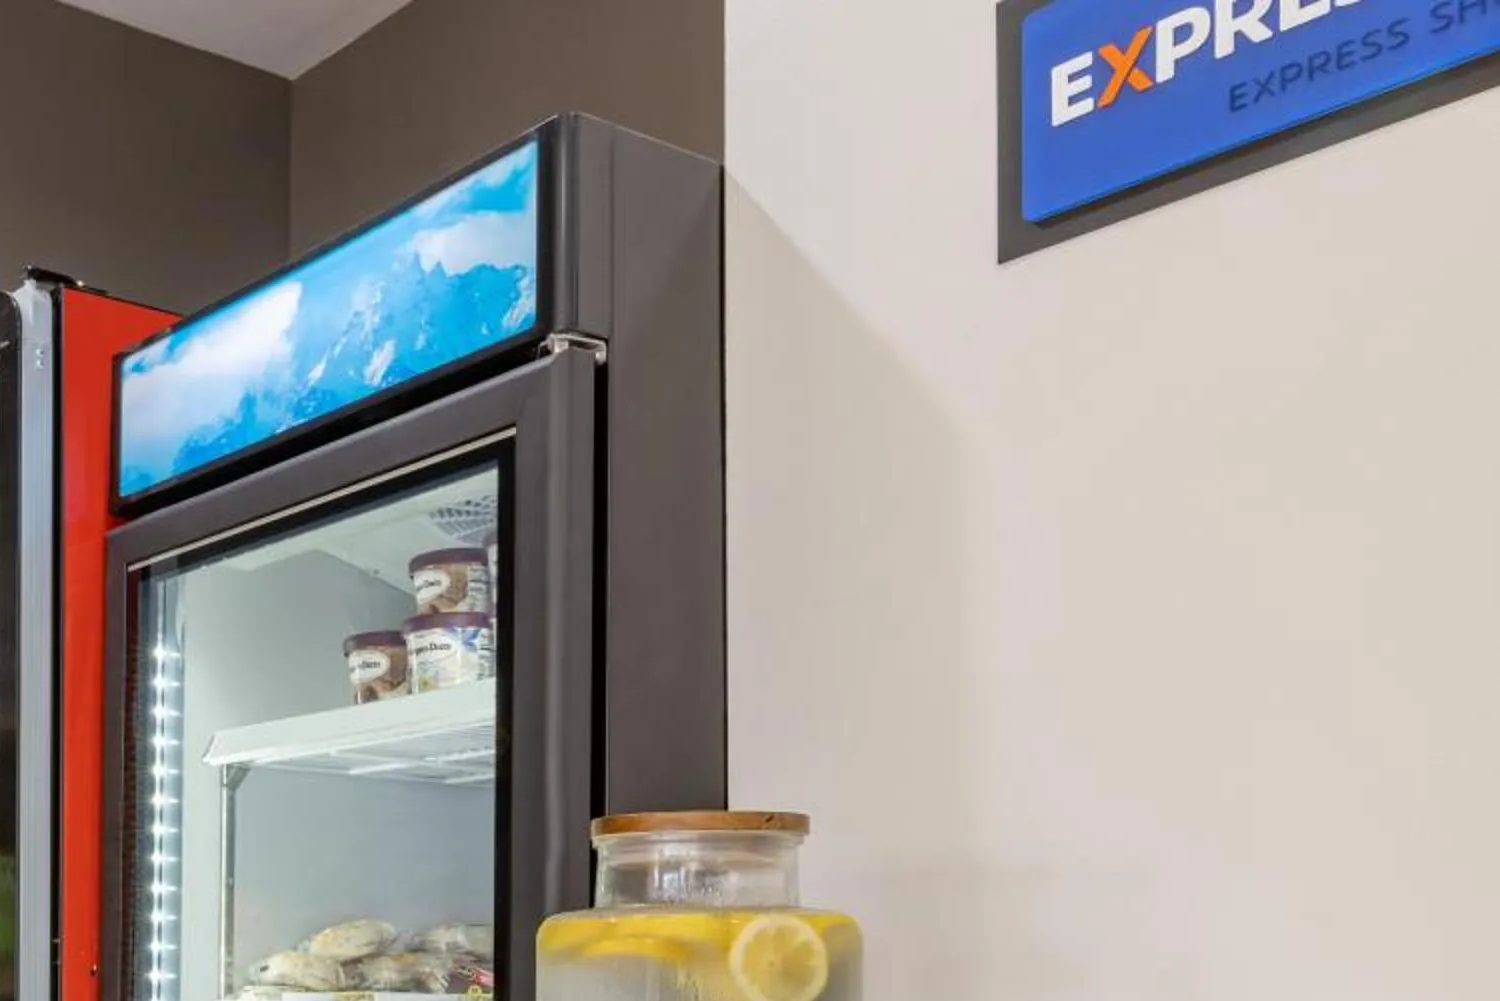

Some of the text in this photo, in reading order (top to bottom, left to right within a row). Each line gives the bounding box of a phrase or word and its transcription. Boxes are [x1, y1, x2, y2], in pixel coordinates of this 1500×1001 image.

[1051, 0, 1360, 127] EXPR
[1228, 0, 1500, 113] EXPRESS SH
